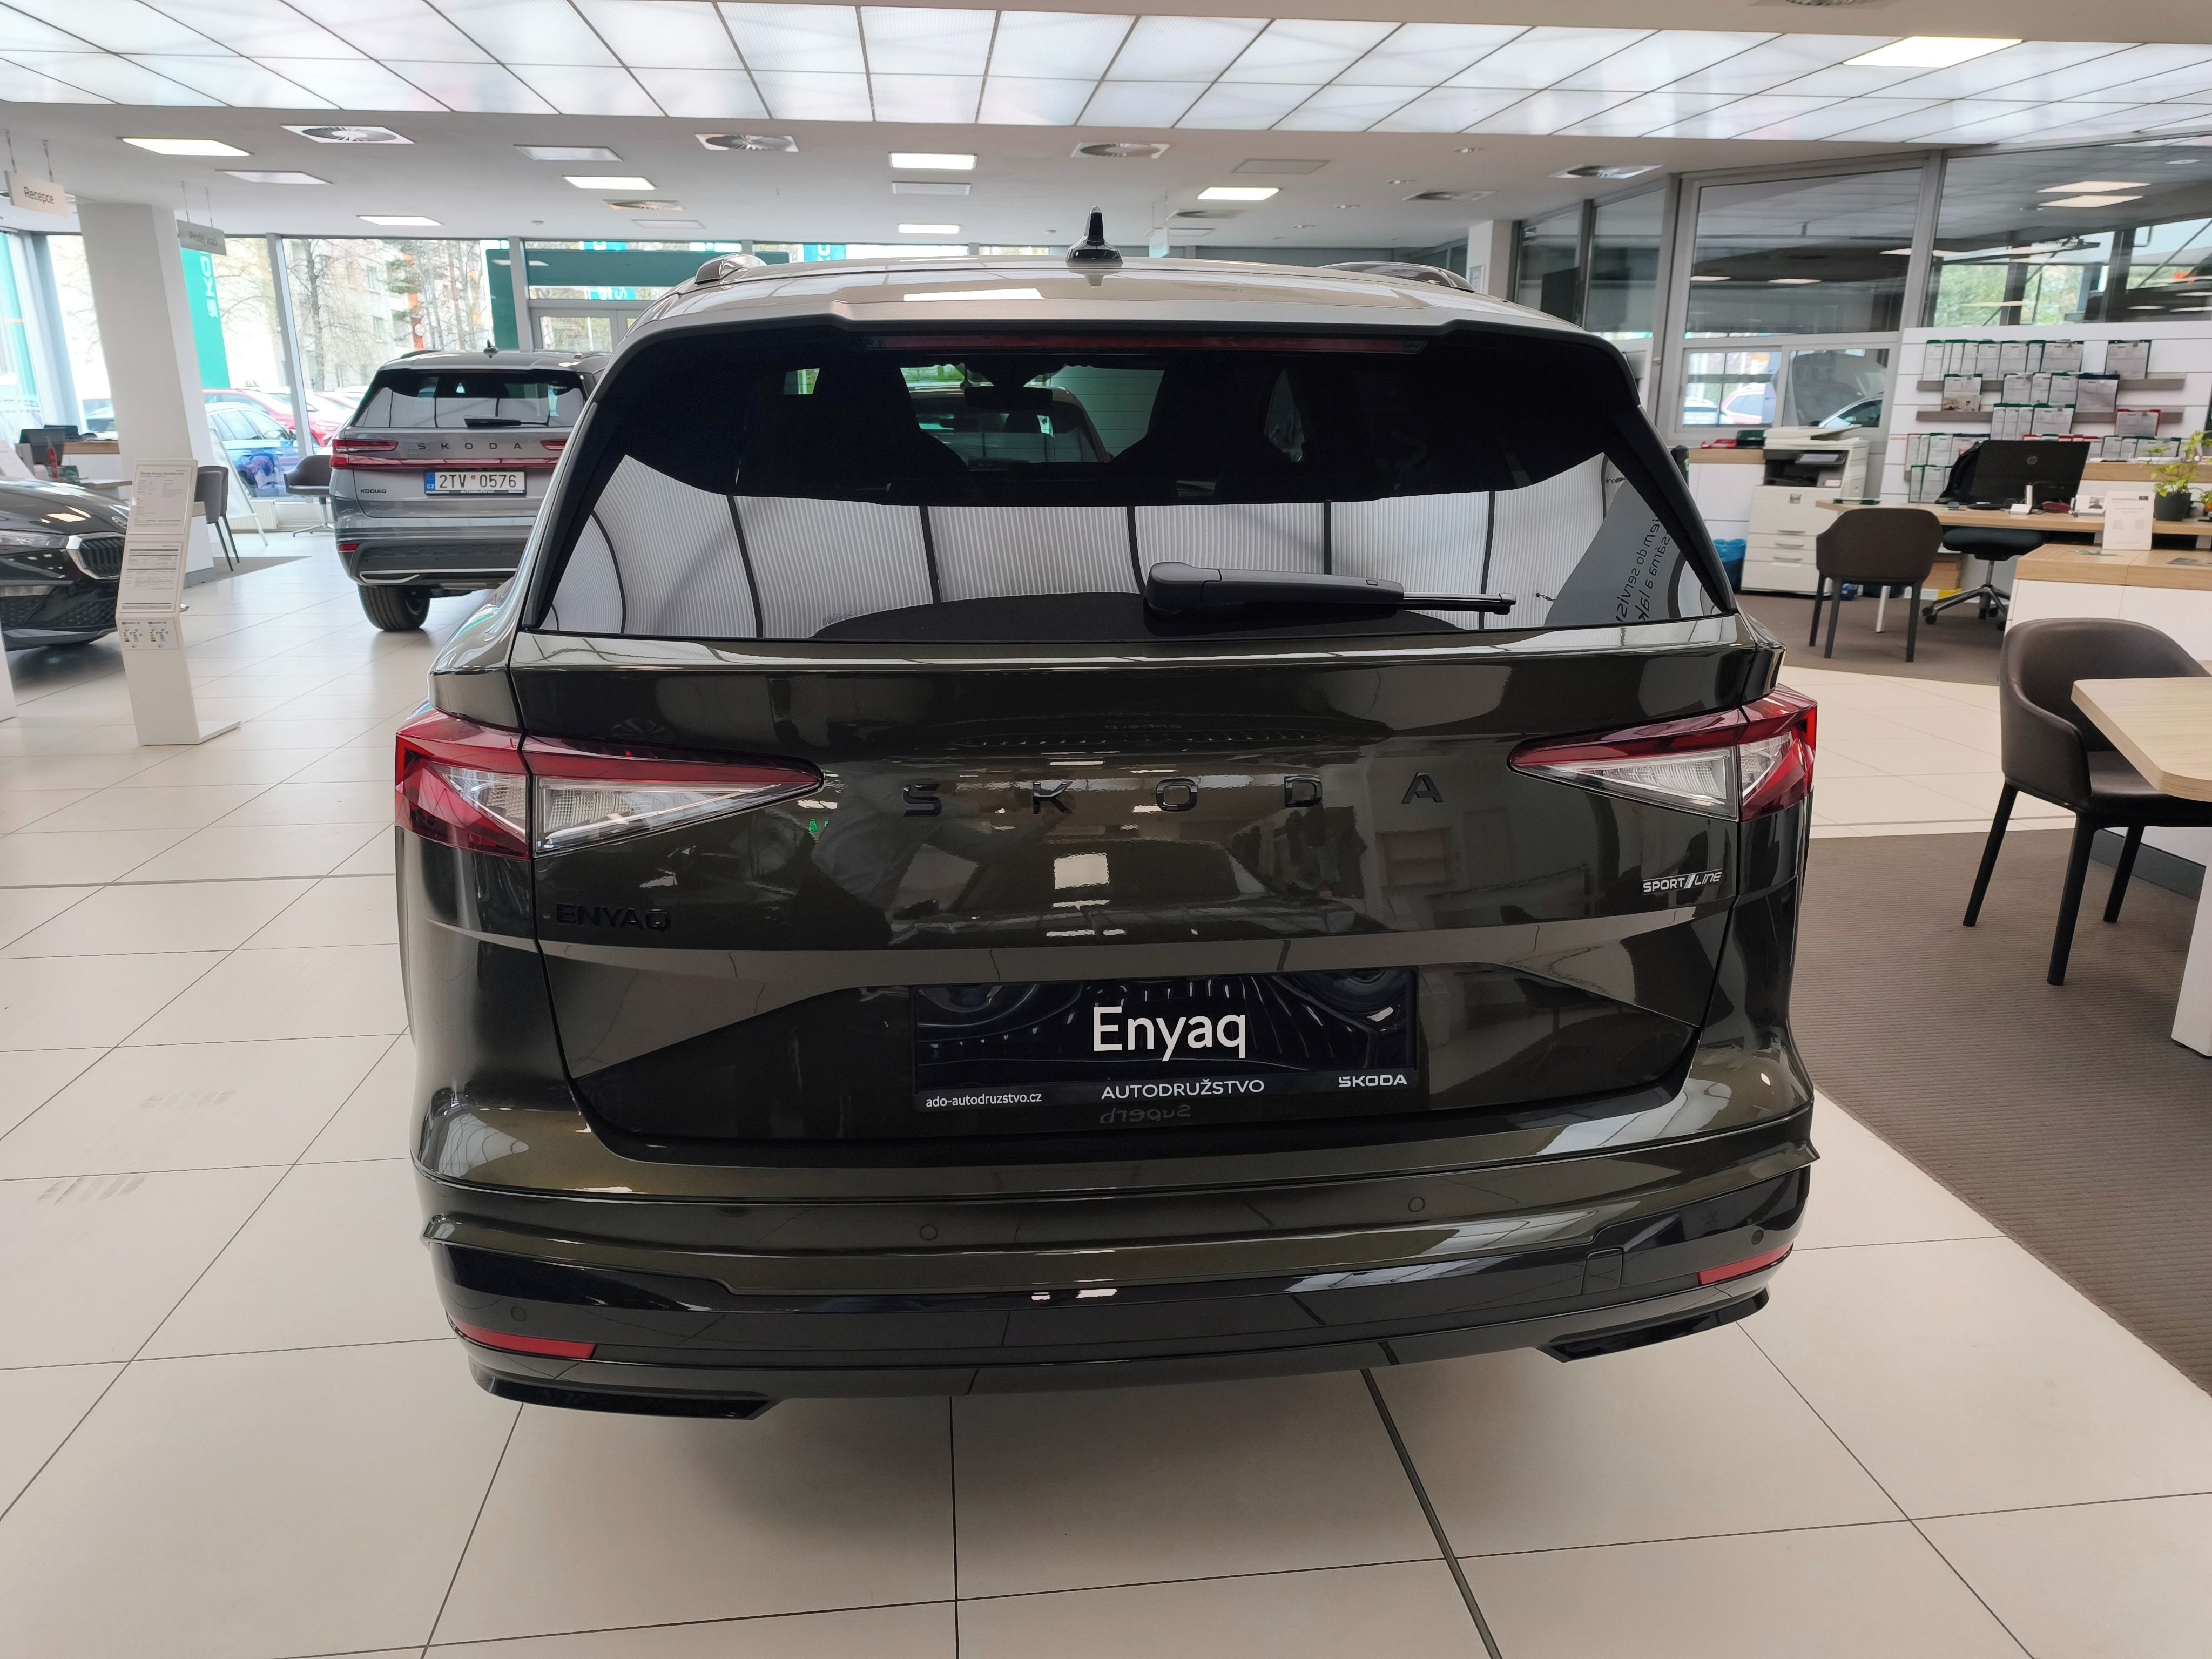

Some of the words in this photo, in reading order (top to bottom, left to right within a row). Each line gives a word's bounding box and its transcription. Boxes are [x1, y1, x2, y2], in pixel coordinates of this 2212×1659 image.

[23, 186, 55, 204] Recepce
[417, 442, 522, 450] SKODA
[439, 474, 466, 488] 2TV
[480, 474, 516, 488] 0576
[902, 771, 1444, 818] SKODA
[557, 903, 671, 932] ENYAQ
[1093, 1006, 1246, 1062] Enyaq
[1101, 1078, 1264, 1100] AUTODRUŽSTVO
[926, 1092, 1042, 1108] ado-autodruzstvo.cz
